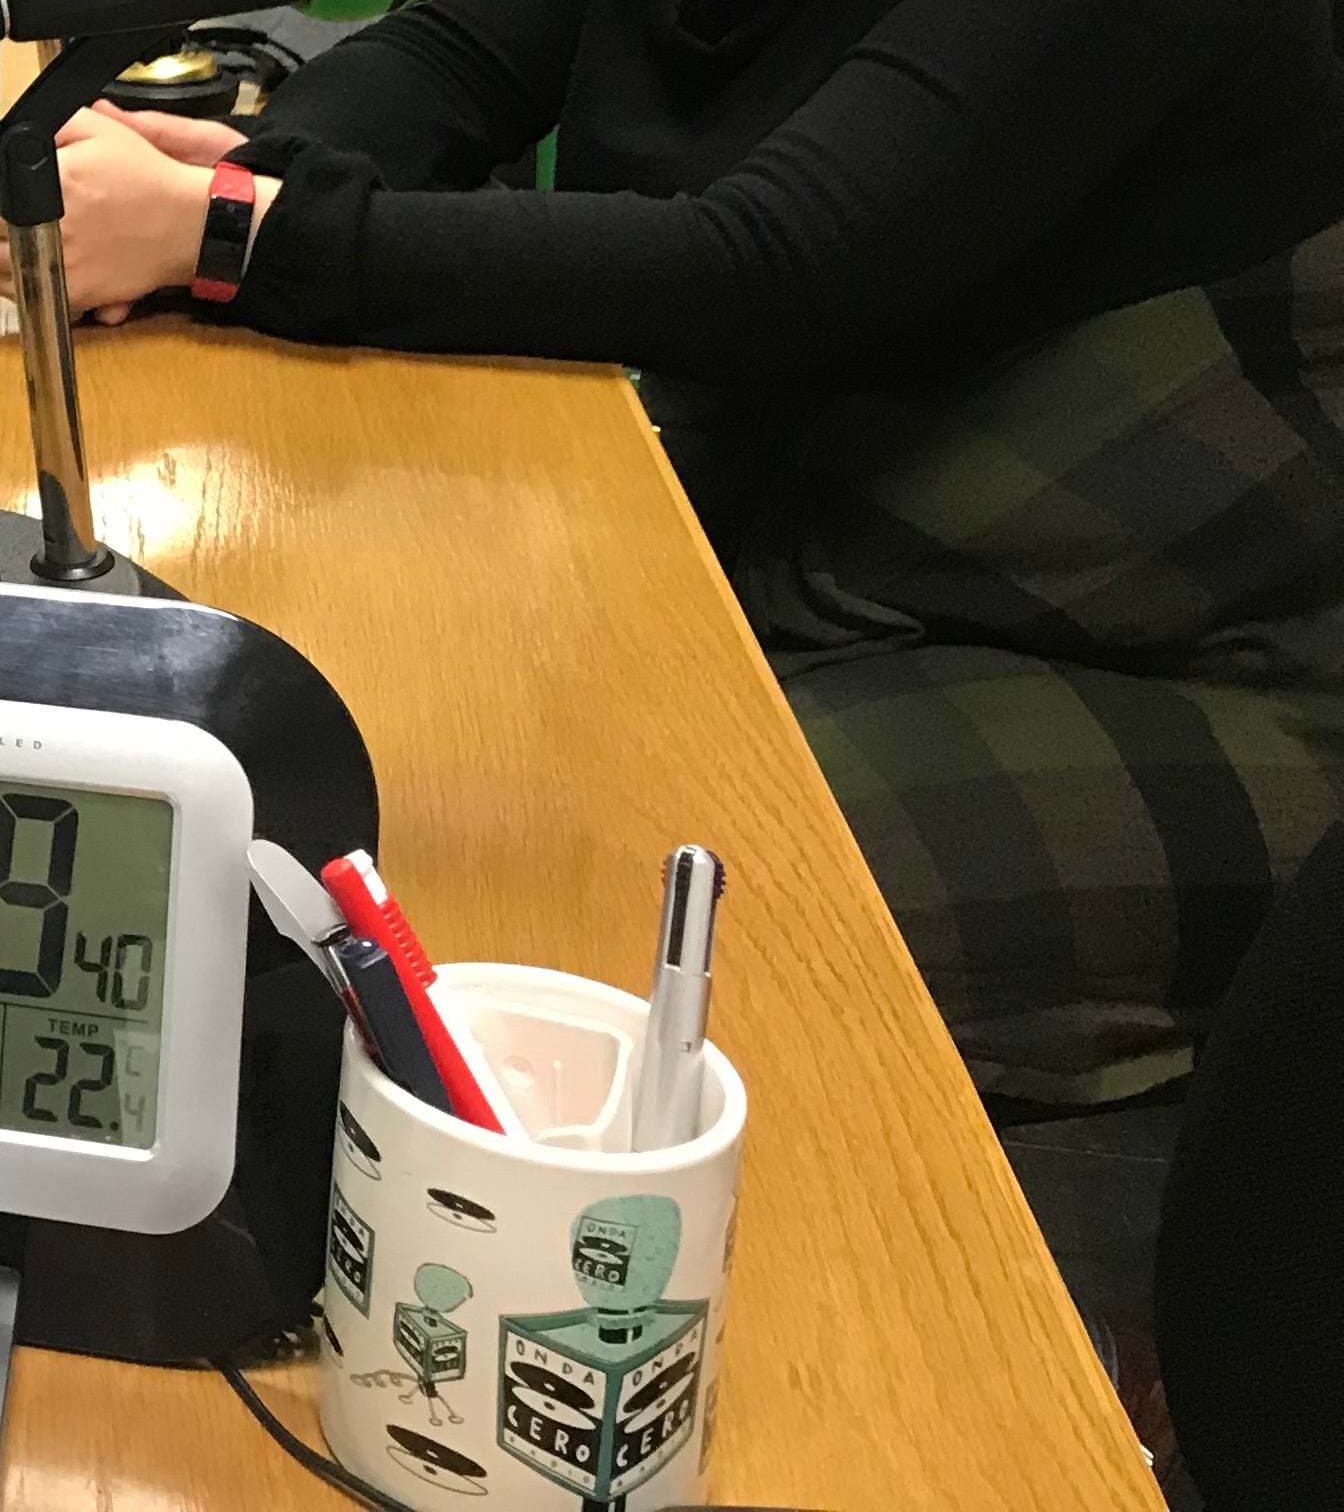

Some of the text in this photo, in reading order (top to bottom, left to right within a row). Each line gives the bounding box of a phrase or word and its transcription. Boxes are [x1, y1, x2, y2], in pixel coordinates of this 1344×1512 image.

[74, 931, 153, 1011] 40
[48, 1018, 100, 1038] TEMP
[586, 1221, 627, 1238] ONDA
[574, 1258, 620, 1283] CERO
[515, 1339, 595, 1386] ONDA
[631, 1328, 699, 1387] ONDA
[507, 1404, 591, 1462] CERO
